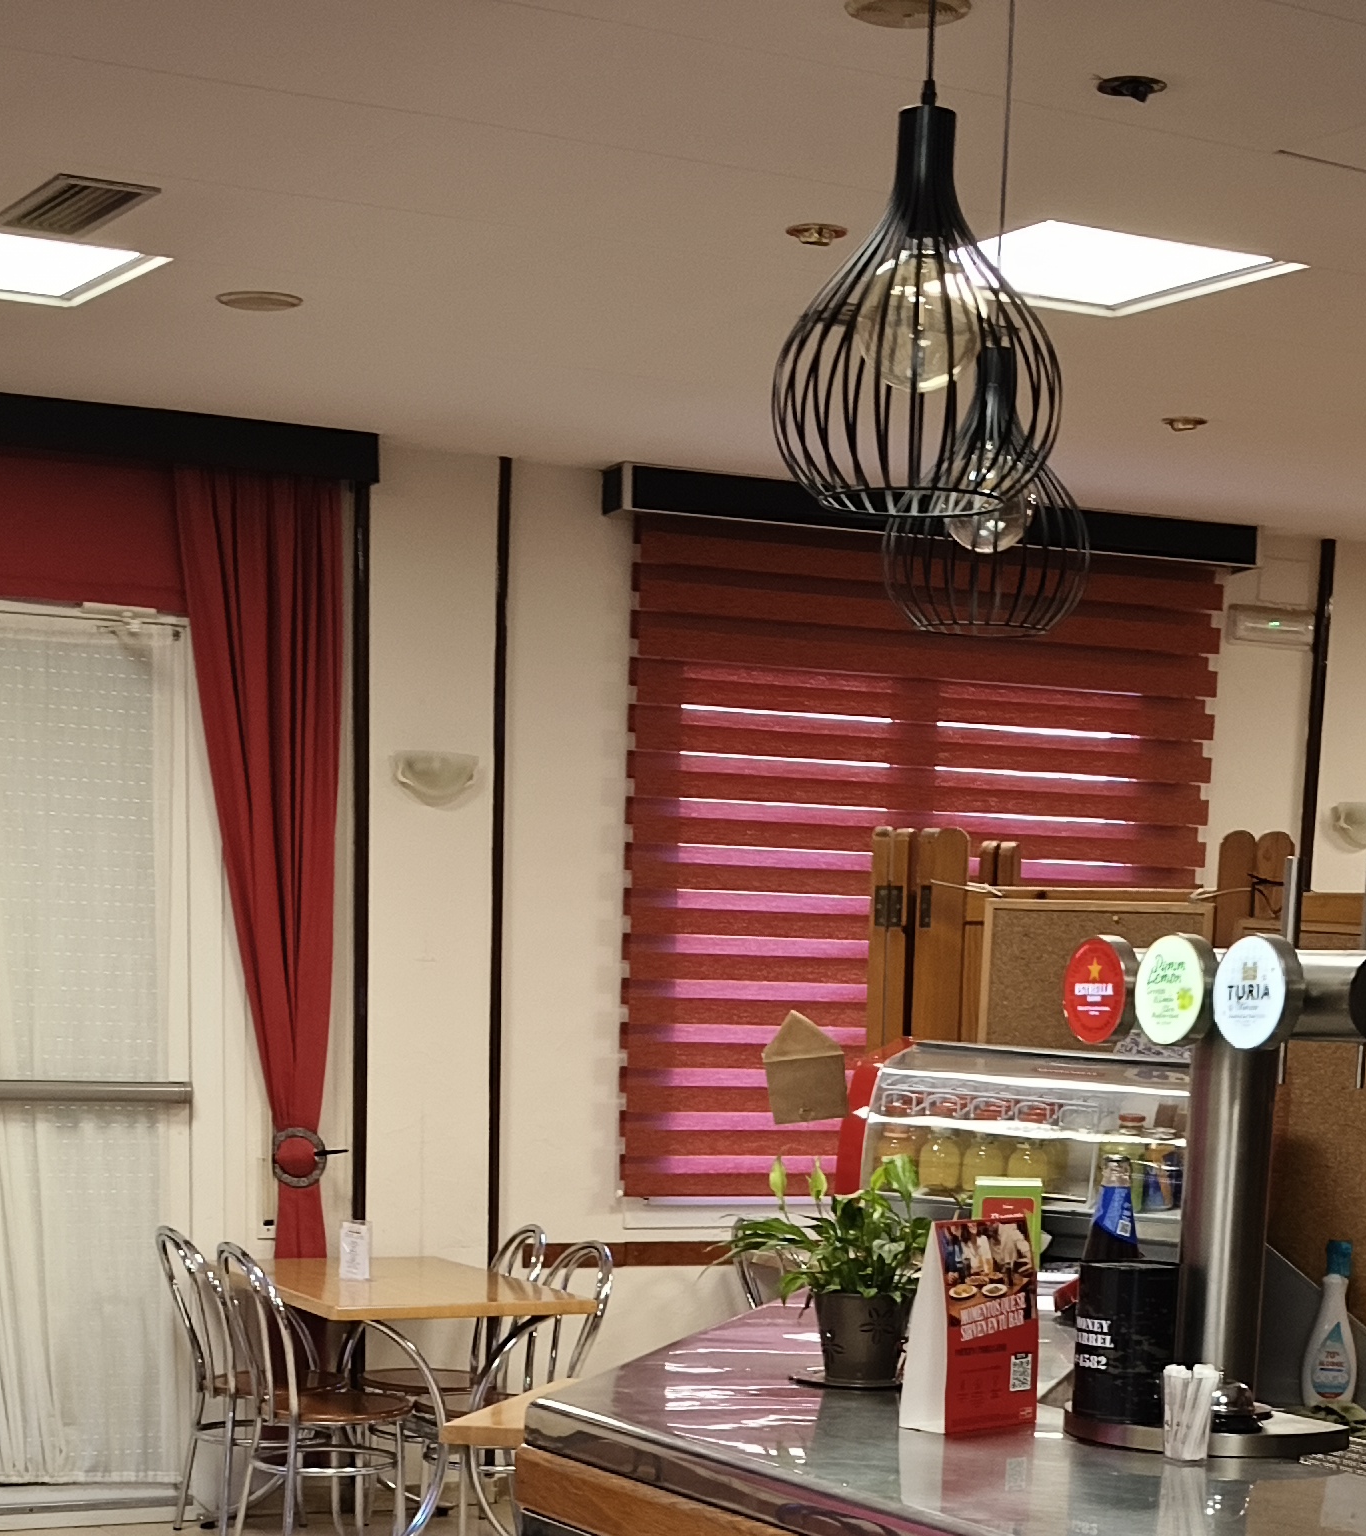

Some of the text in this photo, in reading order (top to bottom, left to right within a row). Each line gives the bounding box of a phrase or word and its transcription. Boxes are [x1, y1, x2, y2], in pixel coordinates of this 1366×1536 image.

[1227, 984, 1270, 1001] TURIA
[1008, 1310, 1025, 1328] BAR
[1076, 1331, 1115, 1348] ARREL
